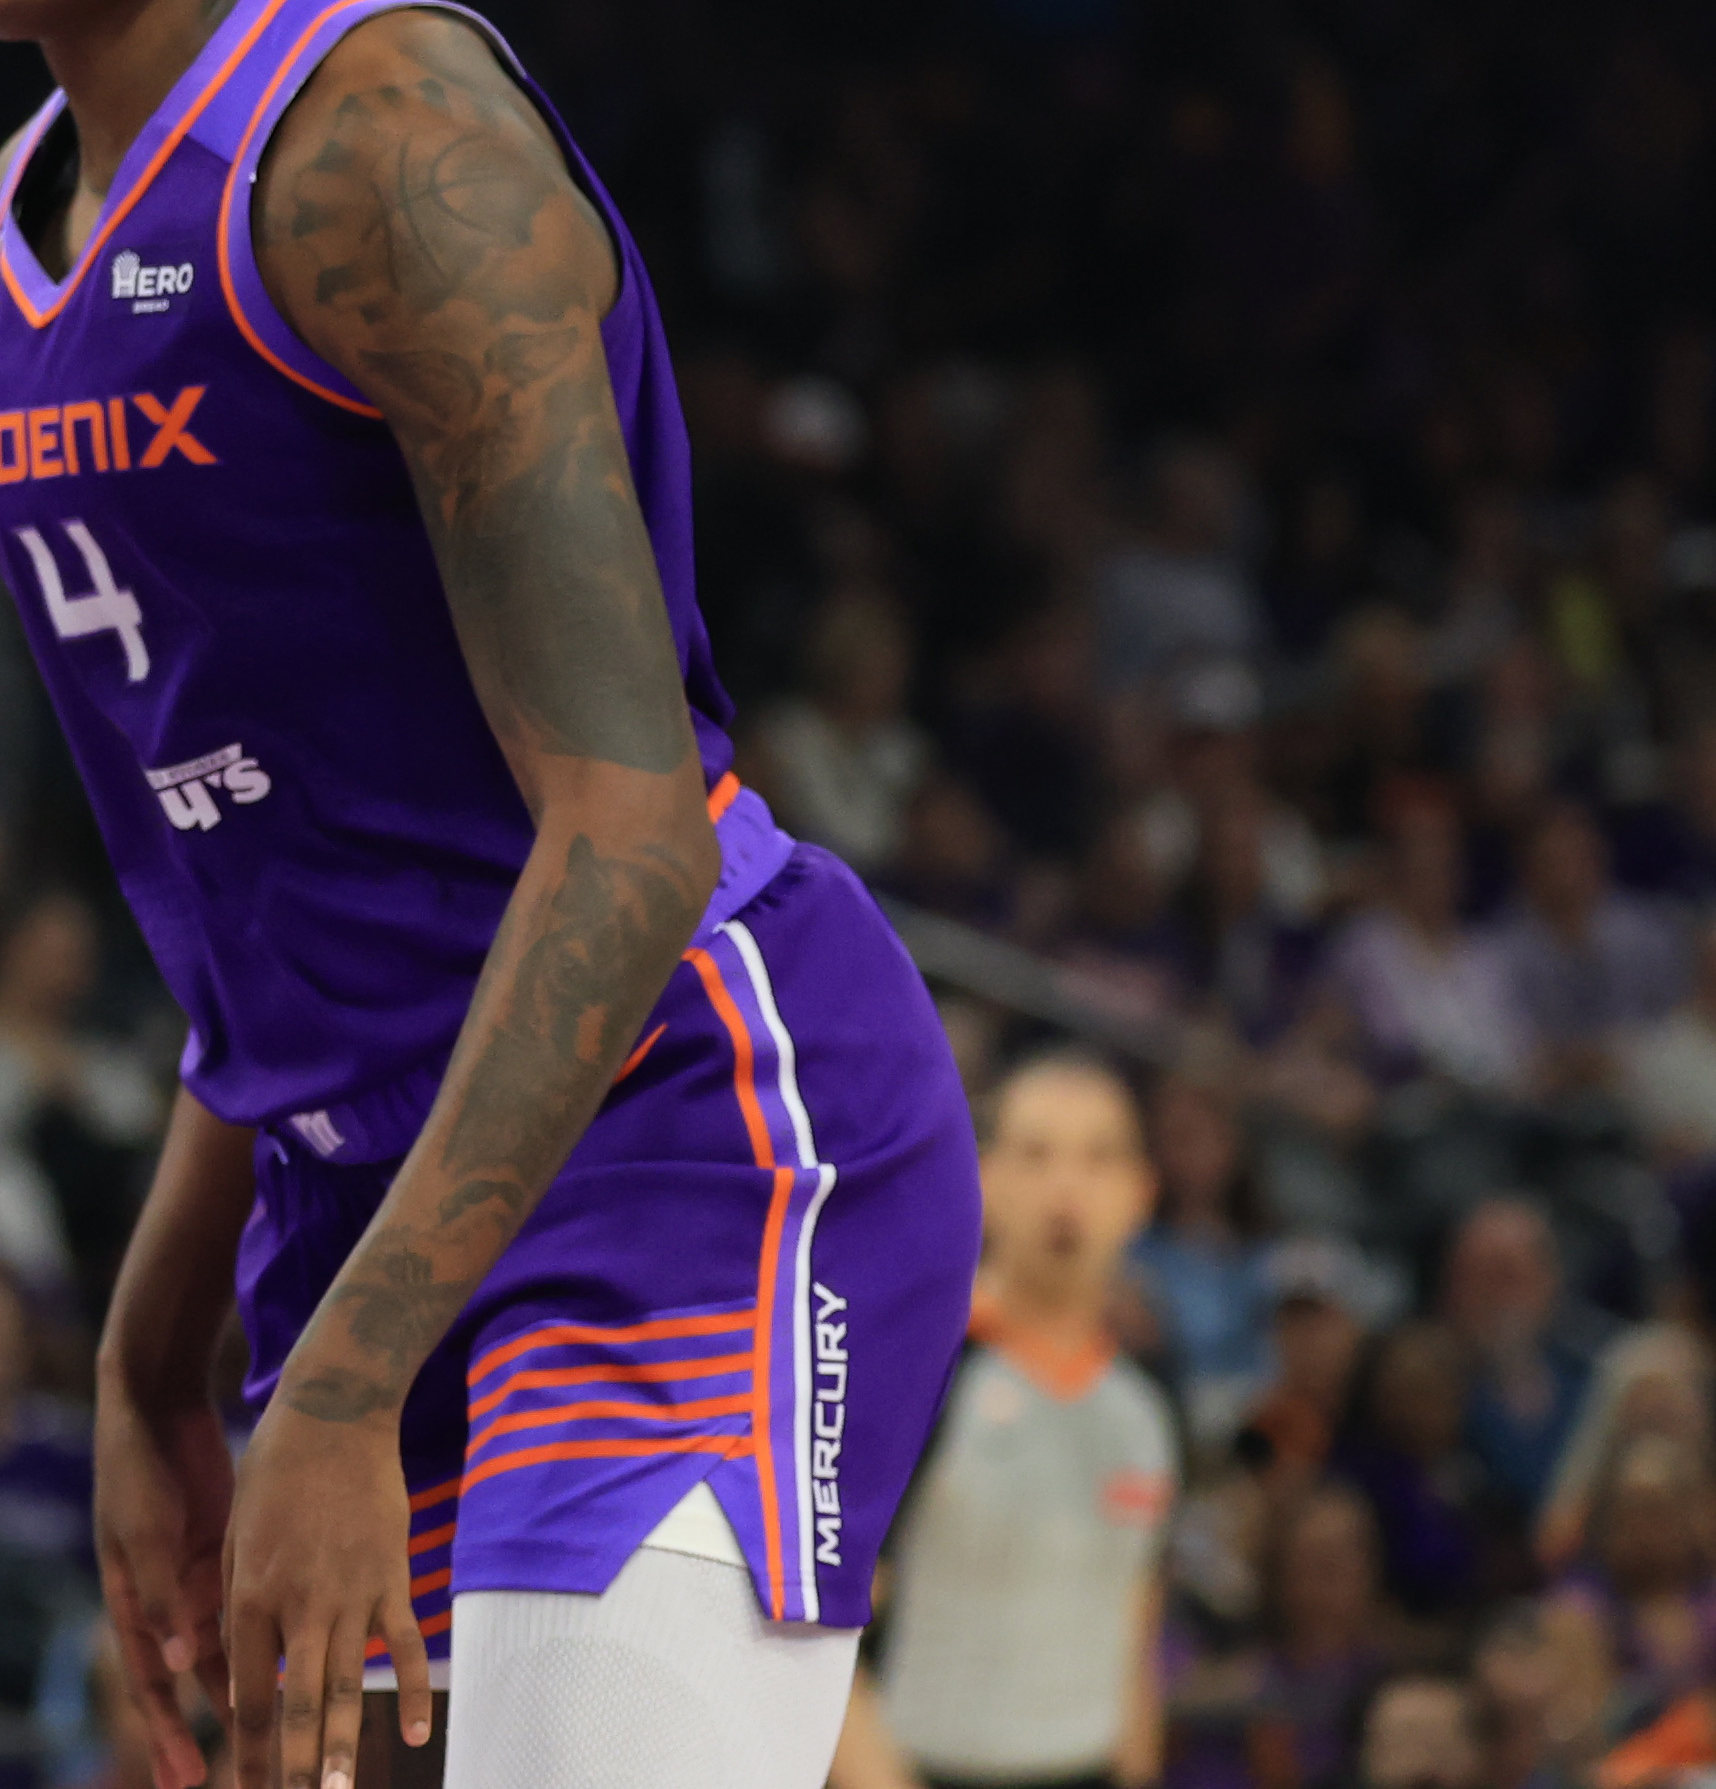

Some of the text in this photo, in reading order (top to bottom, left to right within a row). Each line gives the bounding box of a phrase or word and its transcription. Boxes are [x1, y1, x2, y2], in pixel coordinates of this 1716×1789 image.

[111, 258, 195, 300] HERO
[14, 519, 150, 682] 4
[814, 1281, 849, 1567] MERCURY
